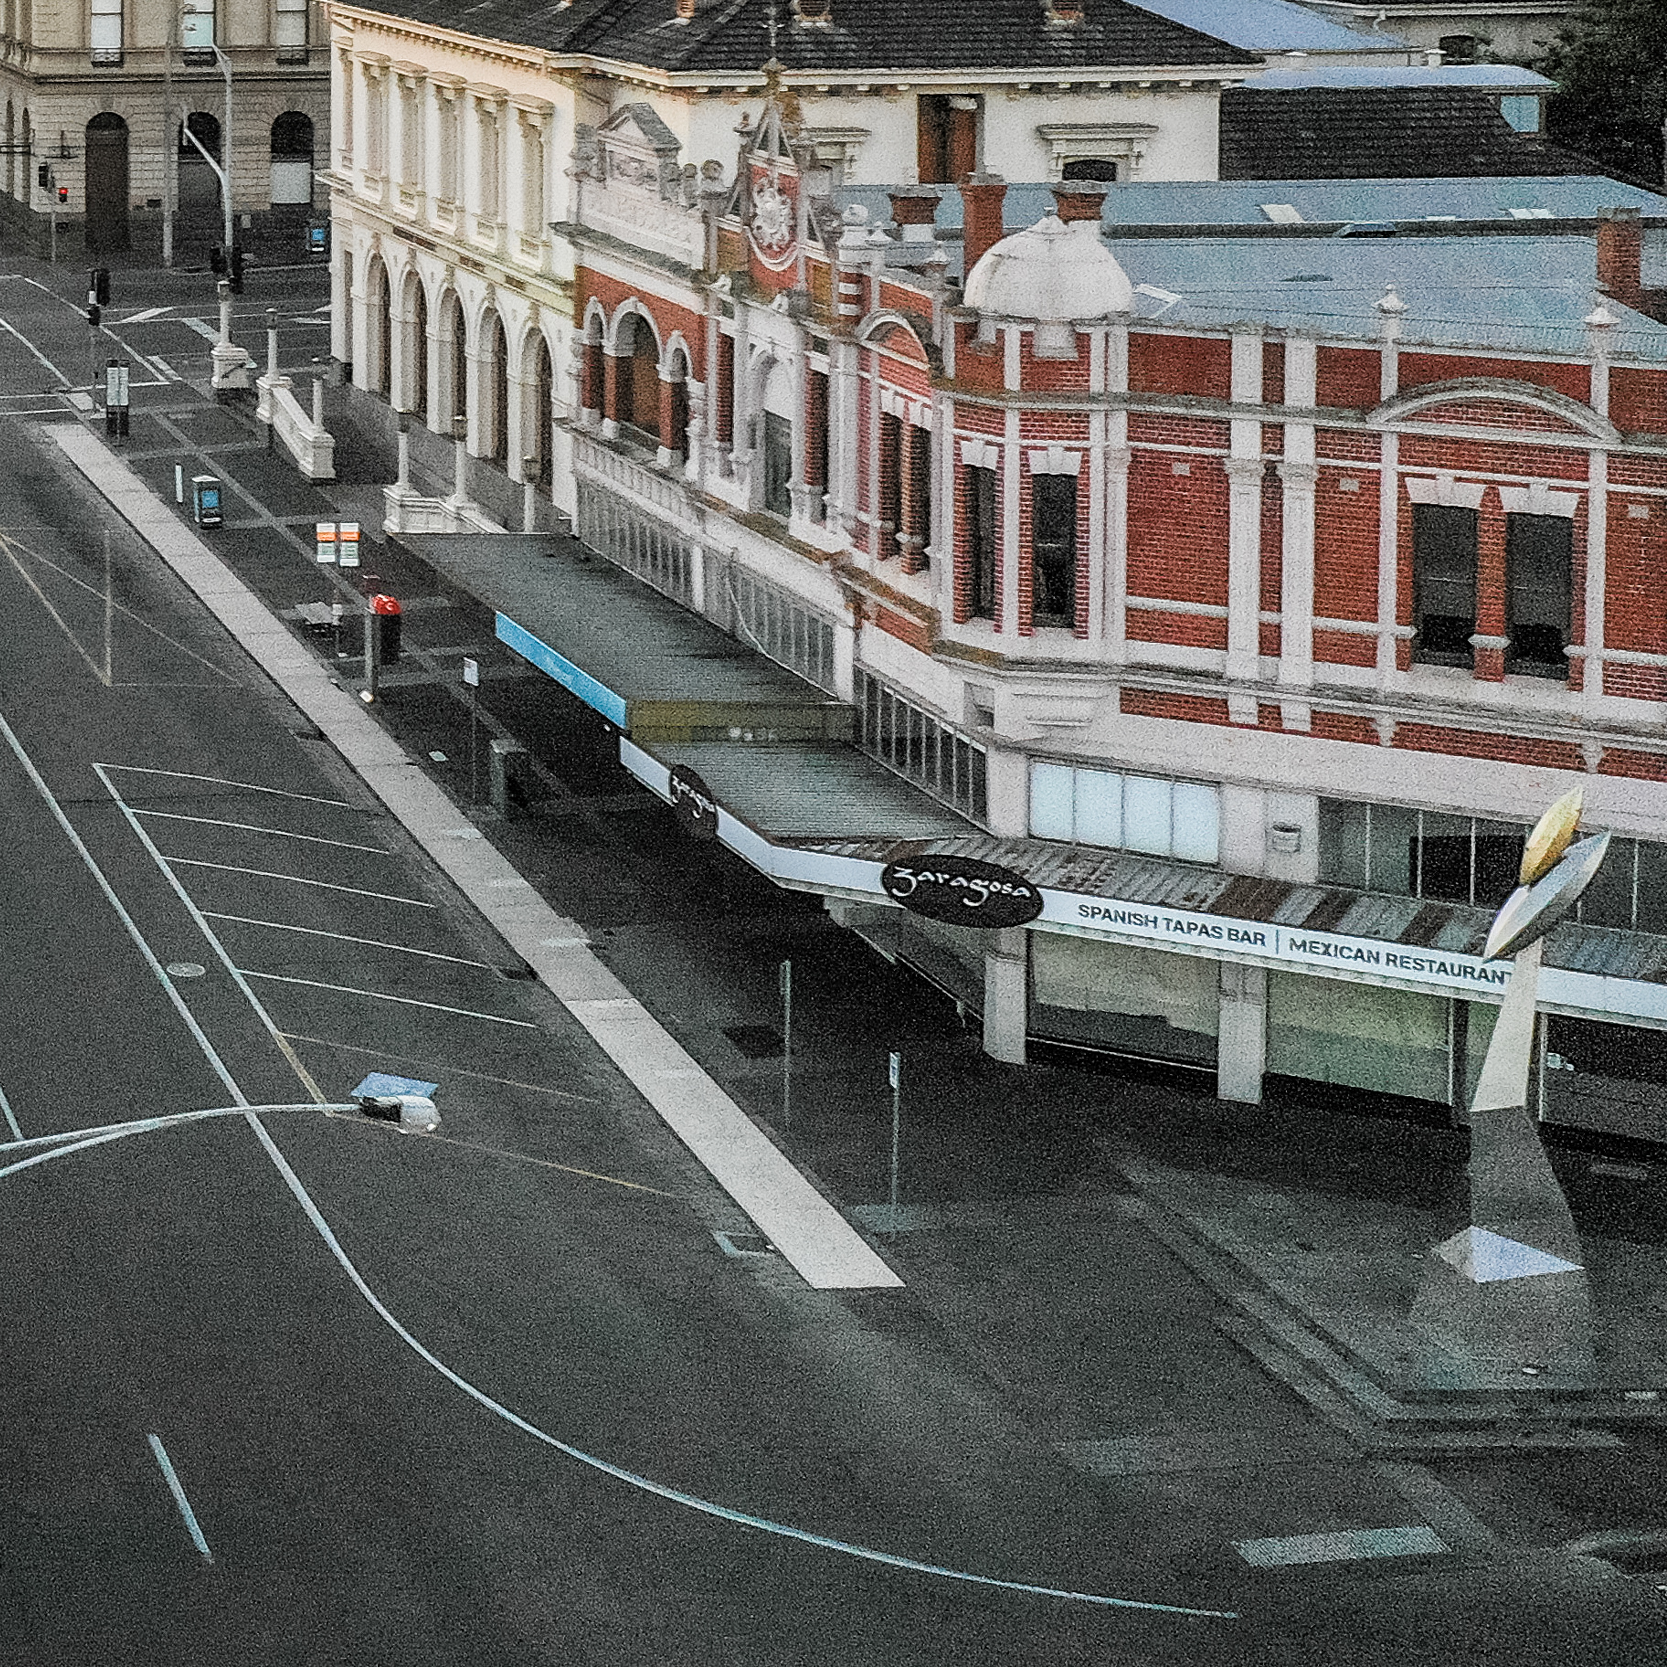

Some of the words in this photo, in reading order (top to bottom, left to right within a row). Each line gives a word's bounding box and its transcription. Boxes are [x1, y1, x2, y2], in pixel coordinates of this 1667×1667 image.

[1078, 904, 1159, 930] SPANISH
[1163, 917, 1223, 939] TAPAS
[1227, 927, 1266, 946] BAR
[1289, 937, 1380, 965] MEXICAN
